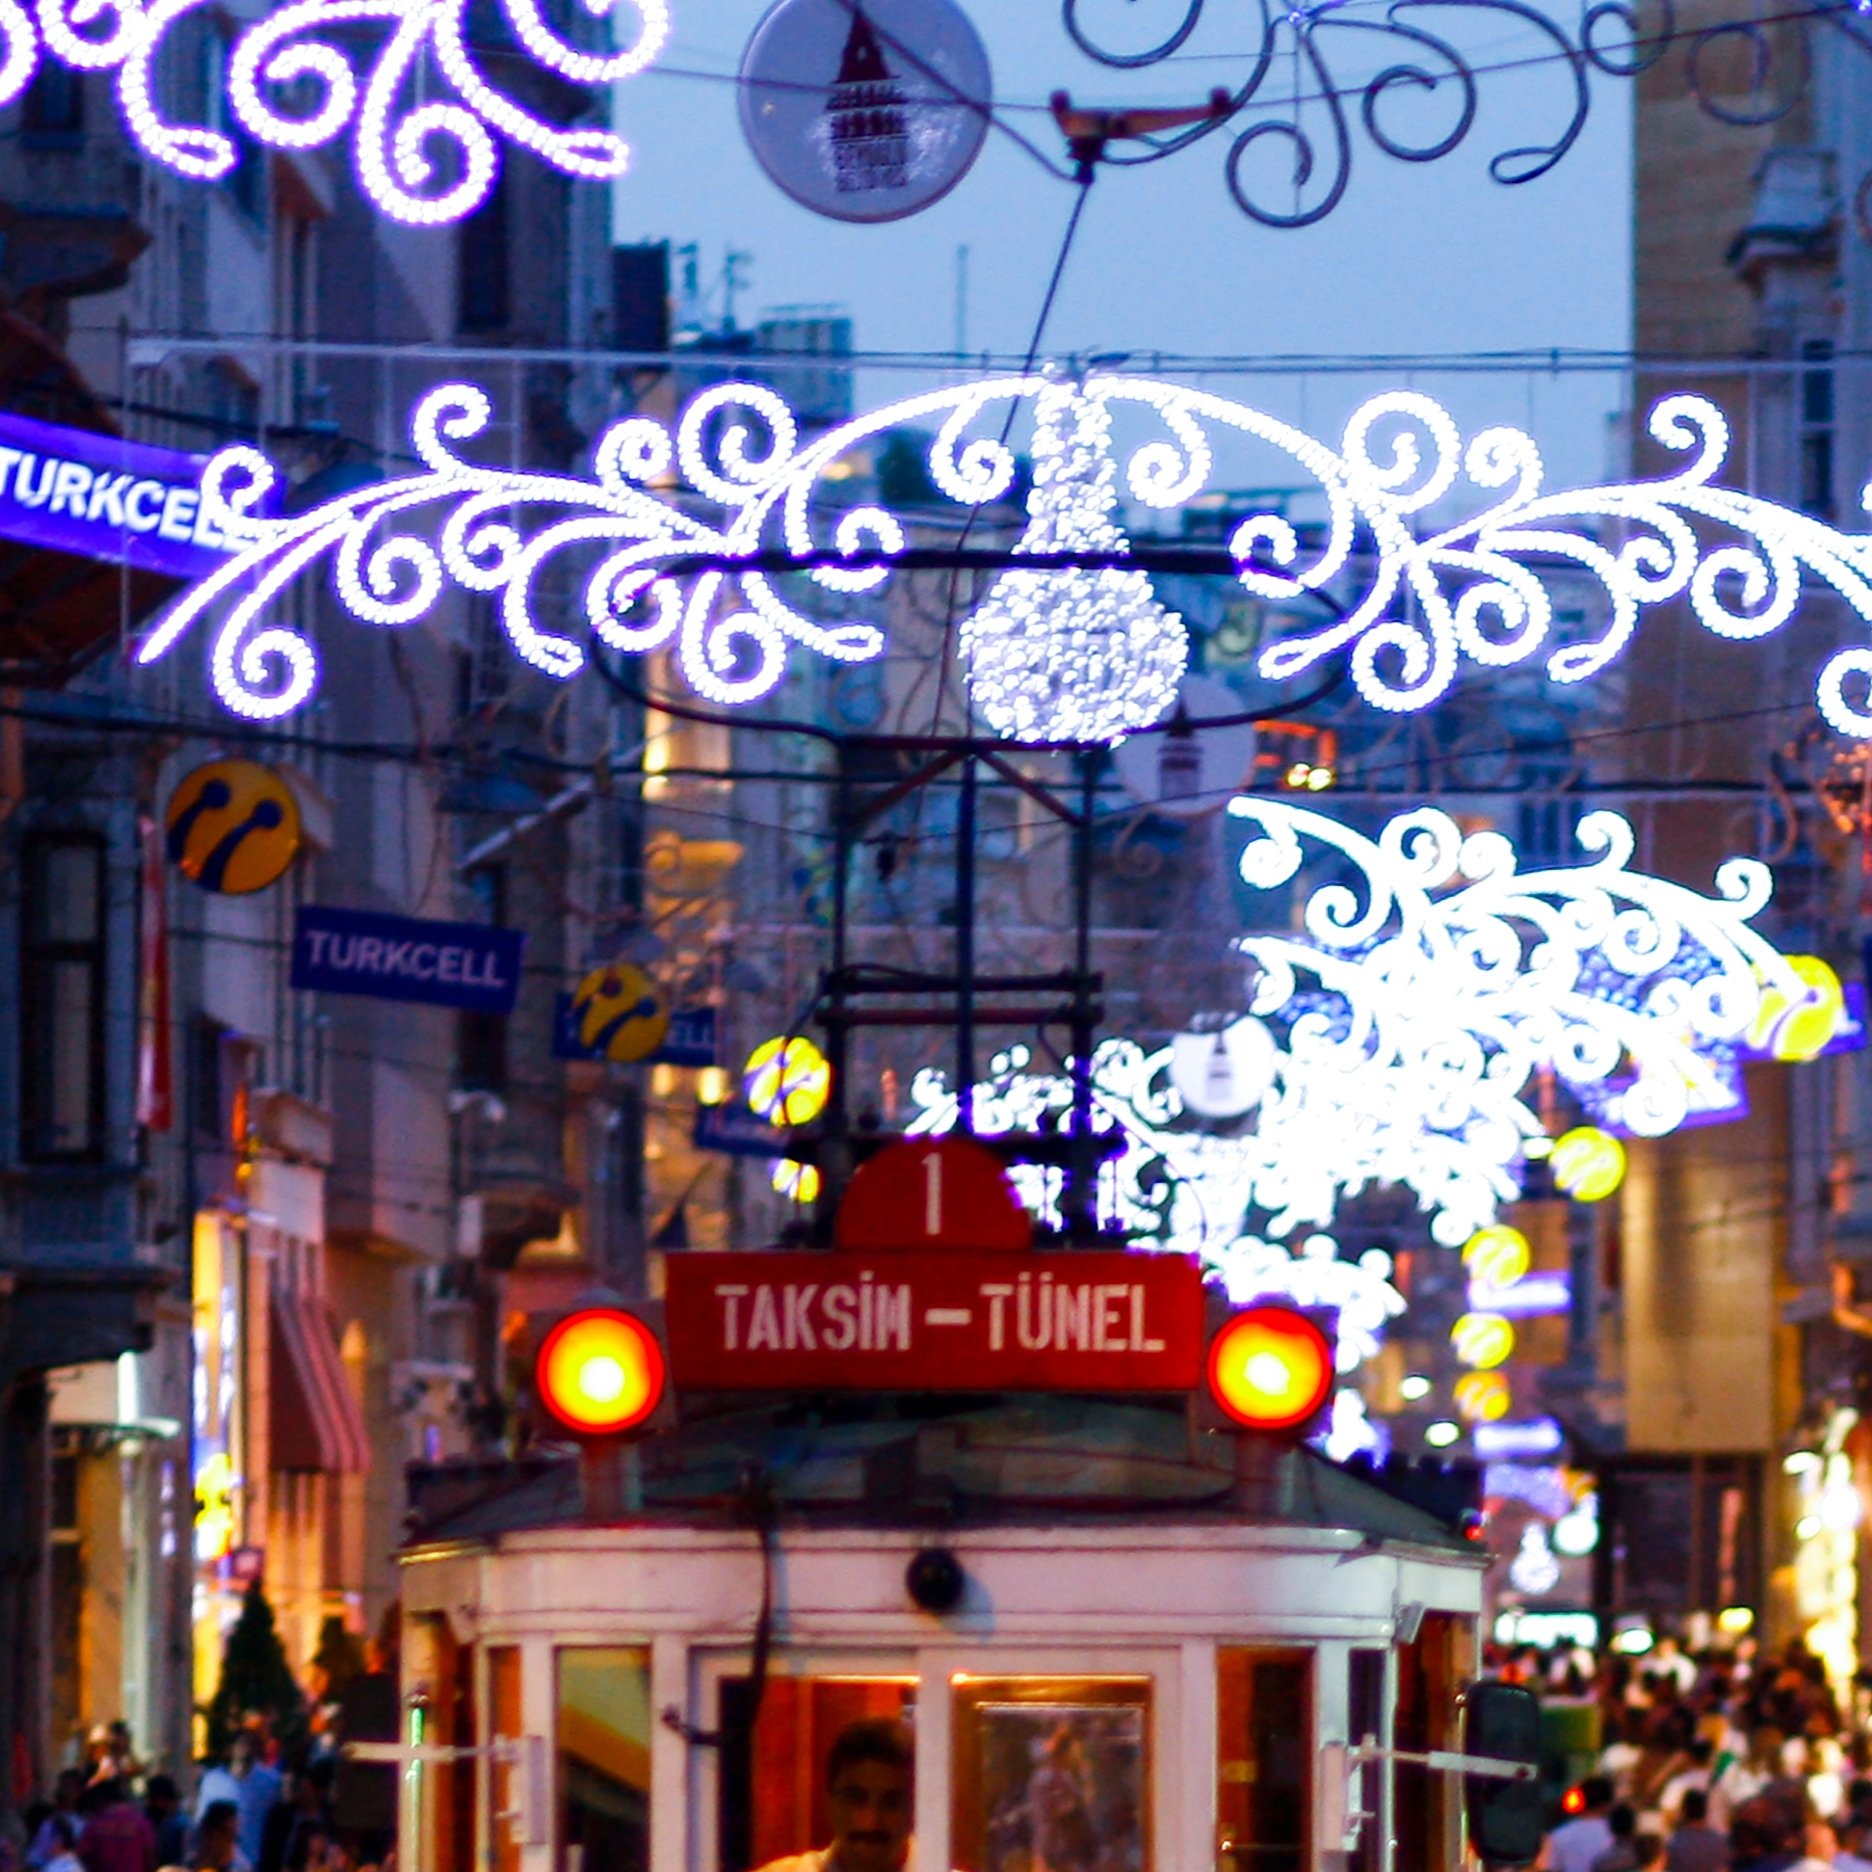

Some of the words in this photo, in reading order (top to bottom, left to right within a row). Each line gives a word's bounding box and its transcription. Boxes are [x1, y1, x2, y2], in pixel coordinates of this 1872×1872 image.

[305, 929, 508, 988] TURKCELL
[920, 1152, 943, 1236] 1
[714, 1270, 913, 1352] TAKSİM
[979, 1271, 1167, 1353] TÜNEL
